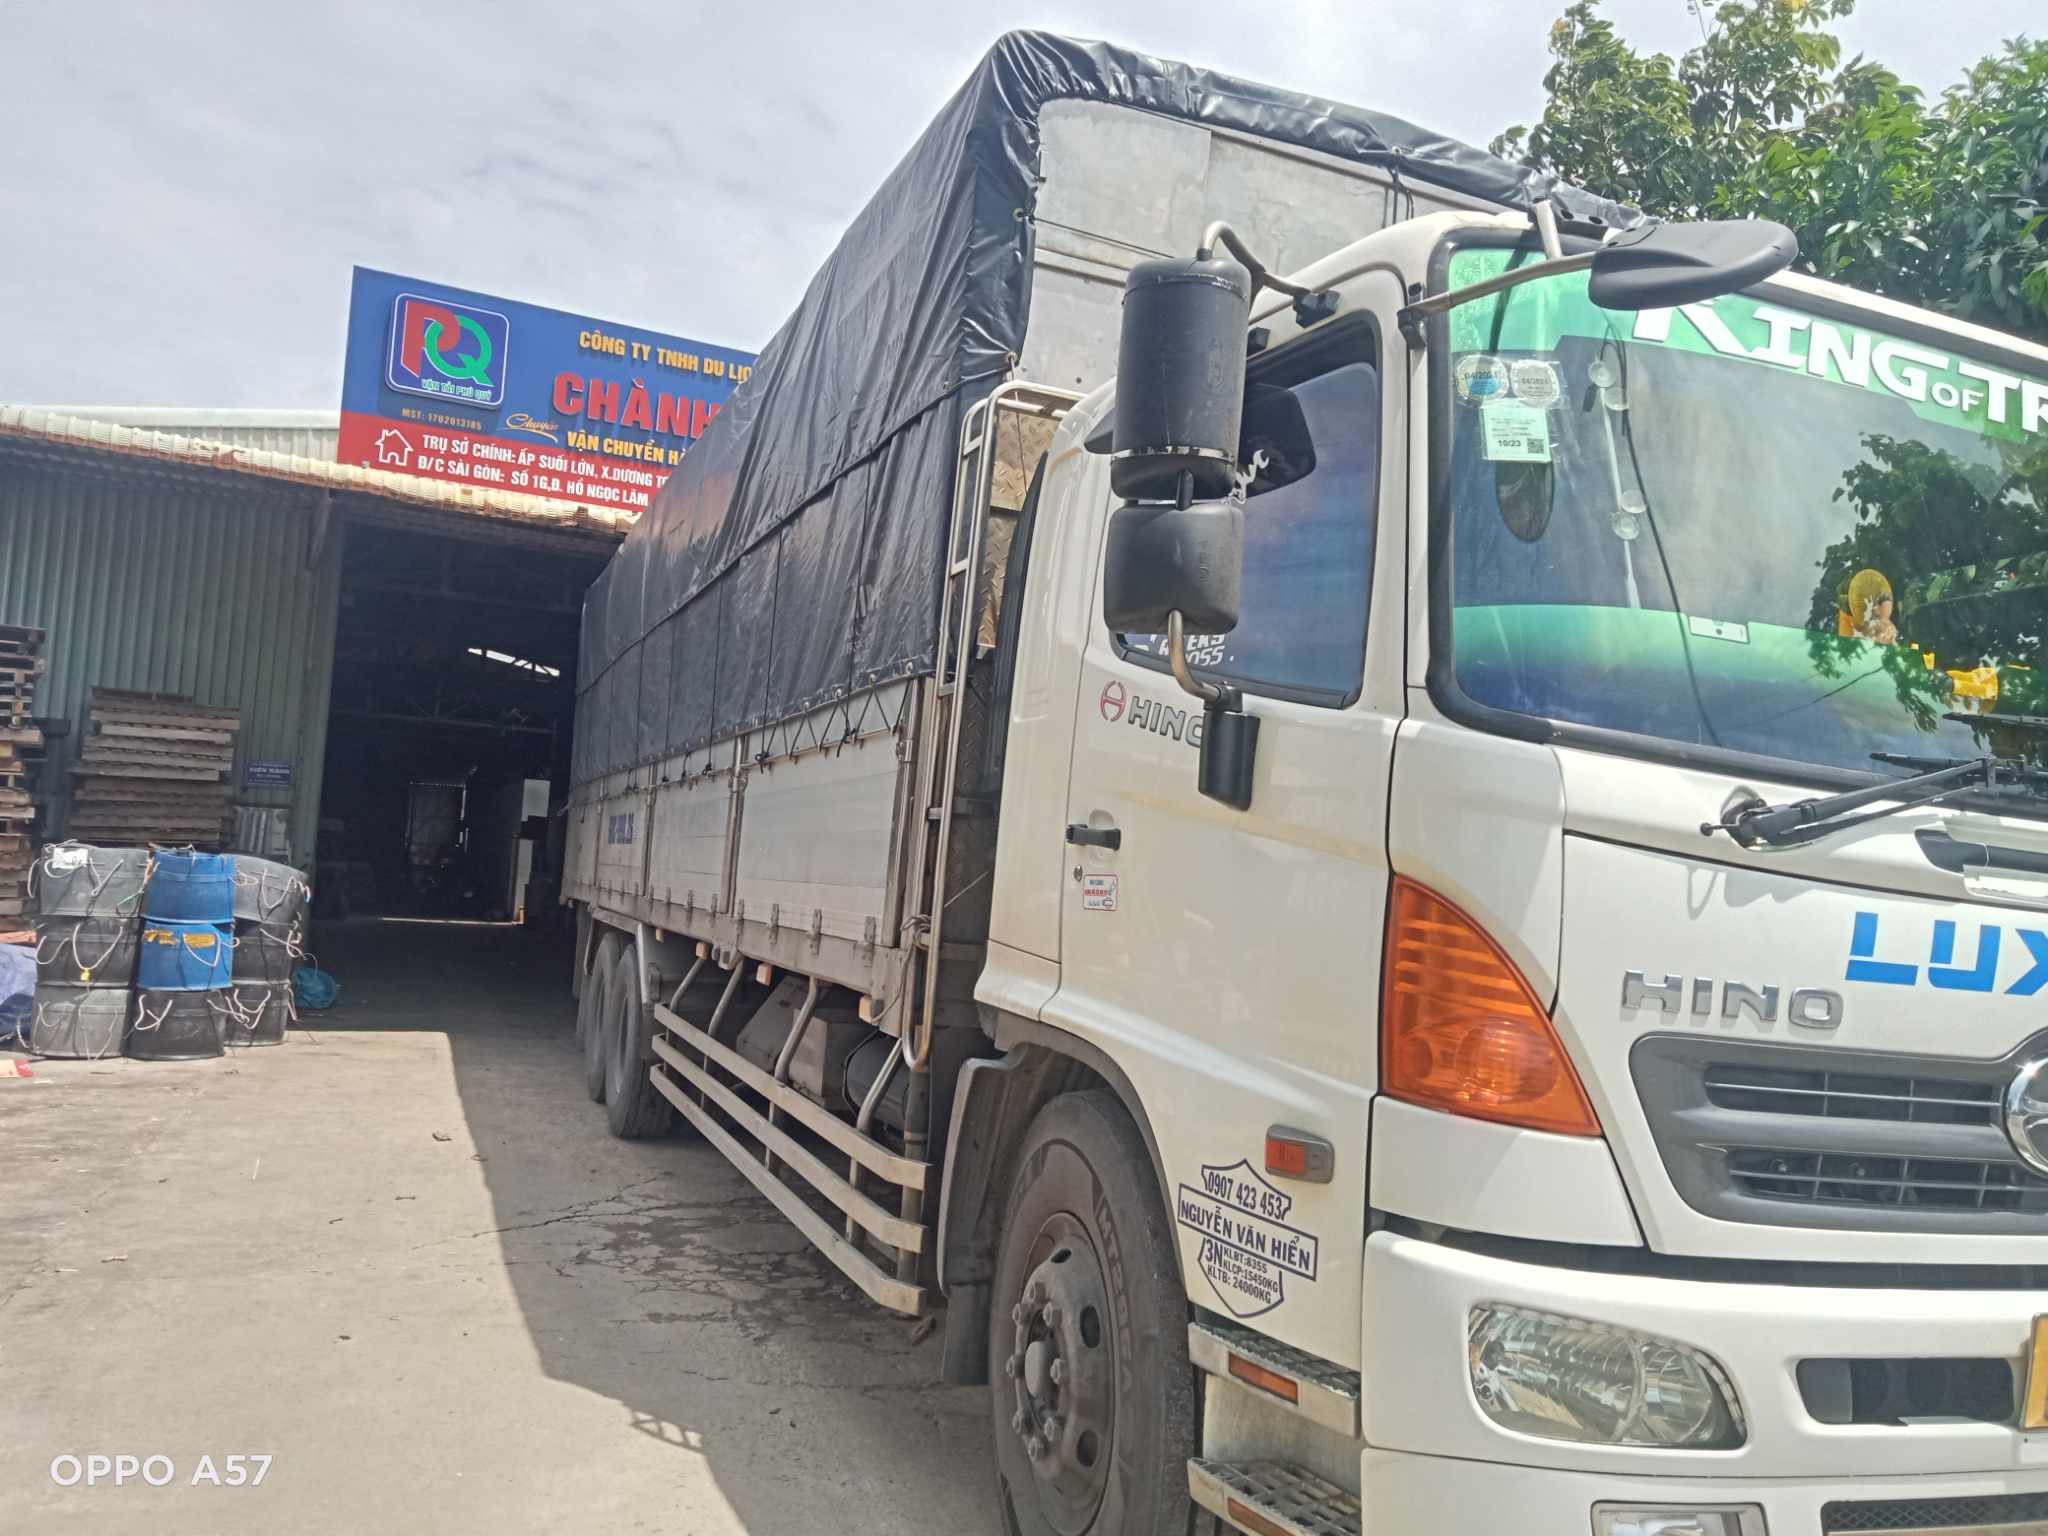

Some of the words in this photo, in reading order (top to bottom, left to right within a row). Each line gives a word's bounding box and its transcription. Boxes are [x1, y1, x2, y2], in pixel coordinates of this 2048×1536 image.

[579, 330, 625, 355] CÔNG
[632, 342, 651, 361] TY
[656, 348, 698, 372] TNHH
[703, 358, 725, 376] DU
[1633, 302, 1949, 402] KING
[1931, 382, 1984, 412] OF
[422, 434, 448, 454] TRỤ
[451, 436, 470, 455] SỞ
[472, 443, 516, 463] CHÍNH:
[517, 447, 536, 466] ẤP
[538, 454, 568, 472] SUỐI
[567, 429, 600, 452] VẬN
[603, 439, 665, 463] CHUYỂN
[417, 455, 444, 472] Đ/C
[447, 459, 469, 477] SÀI
[473, 464, 504, 482] GÒN:
[511, 469, 529, 486] SỐ
[587, 483, 620, 502] NGỌC
[1621, 969, 1844, 1029] HINO
[1208, 1171, 1234, 1200] 0907
[1236, 1182, 1257, 1210] 423
[1259, 1192, 1283, 1220] 453
[1181, 1200, 1233, 1240] NGUYỄN
[1236, 1223, 1266, 1253] VĂN
[1271, 1236, 1311, 1272] HIỂN
[1205, 1239, 1223, 1267] 3N
